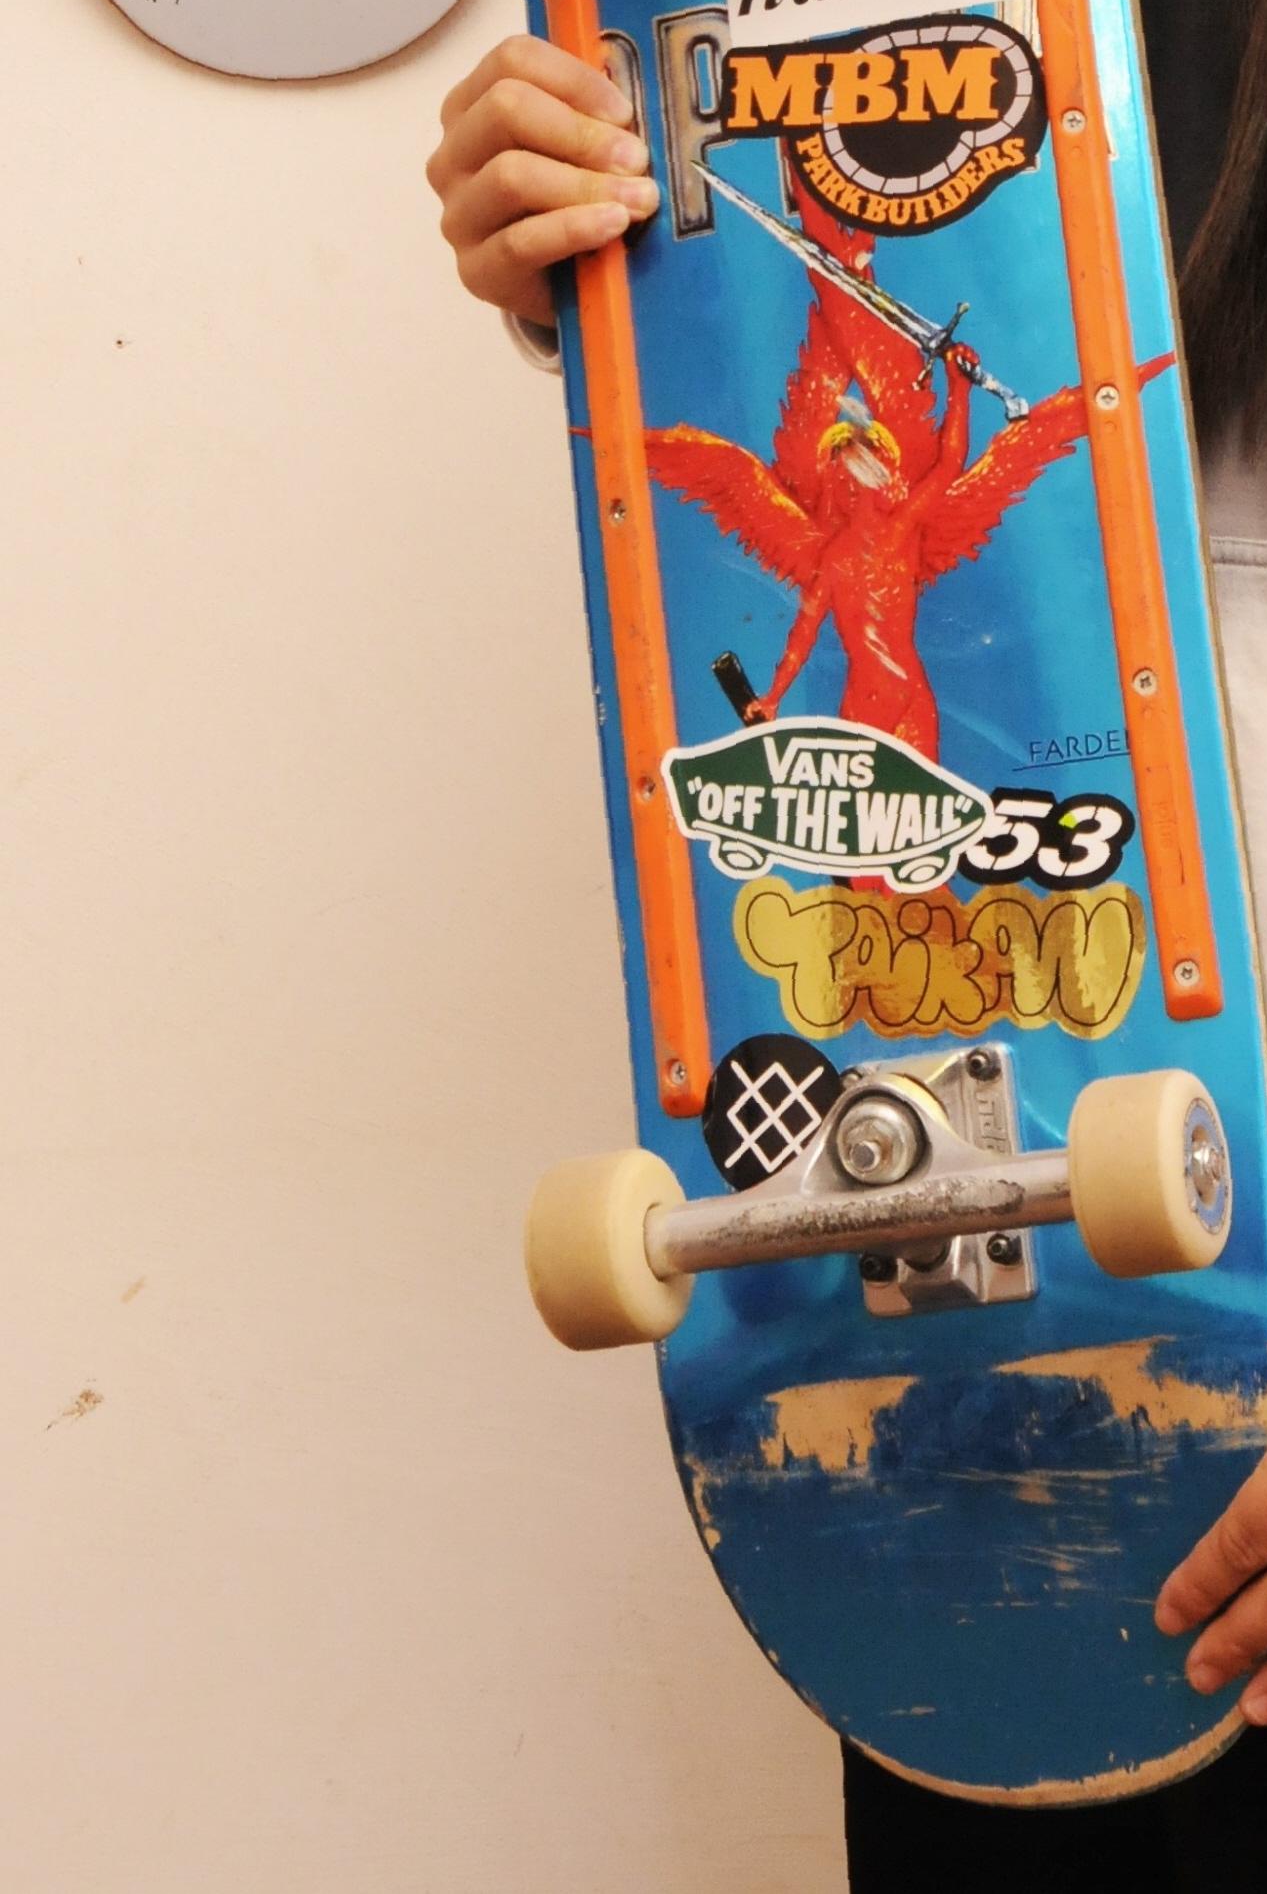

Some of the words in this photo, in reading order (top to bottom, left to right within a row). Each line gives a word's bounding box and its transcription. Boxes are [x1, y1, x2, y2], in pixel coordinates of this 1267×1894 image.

[727, 46, 1003, 129] MBM
[763, 736, 877, 789] VANS
[1029, 729, 1130, 762] FARDE
[771, 786, 851, 854] THE
[967, 799, 1123, 876] 53
